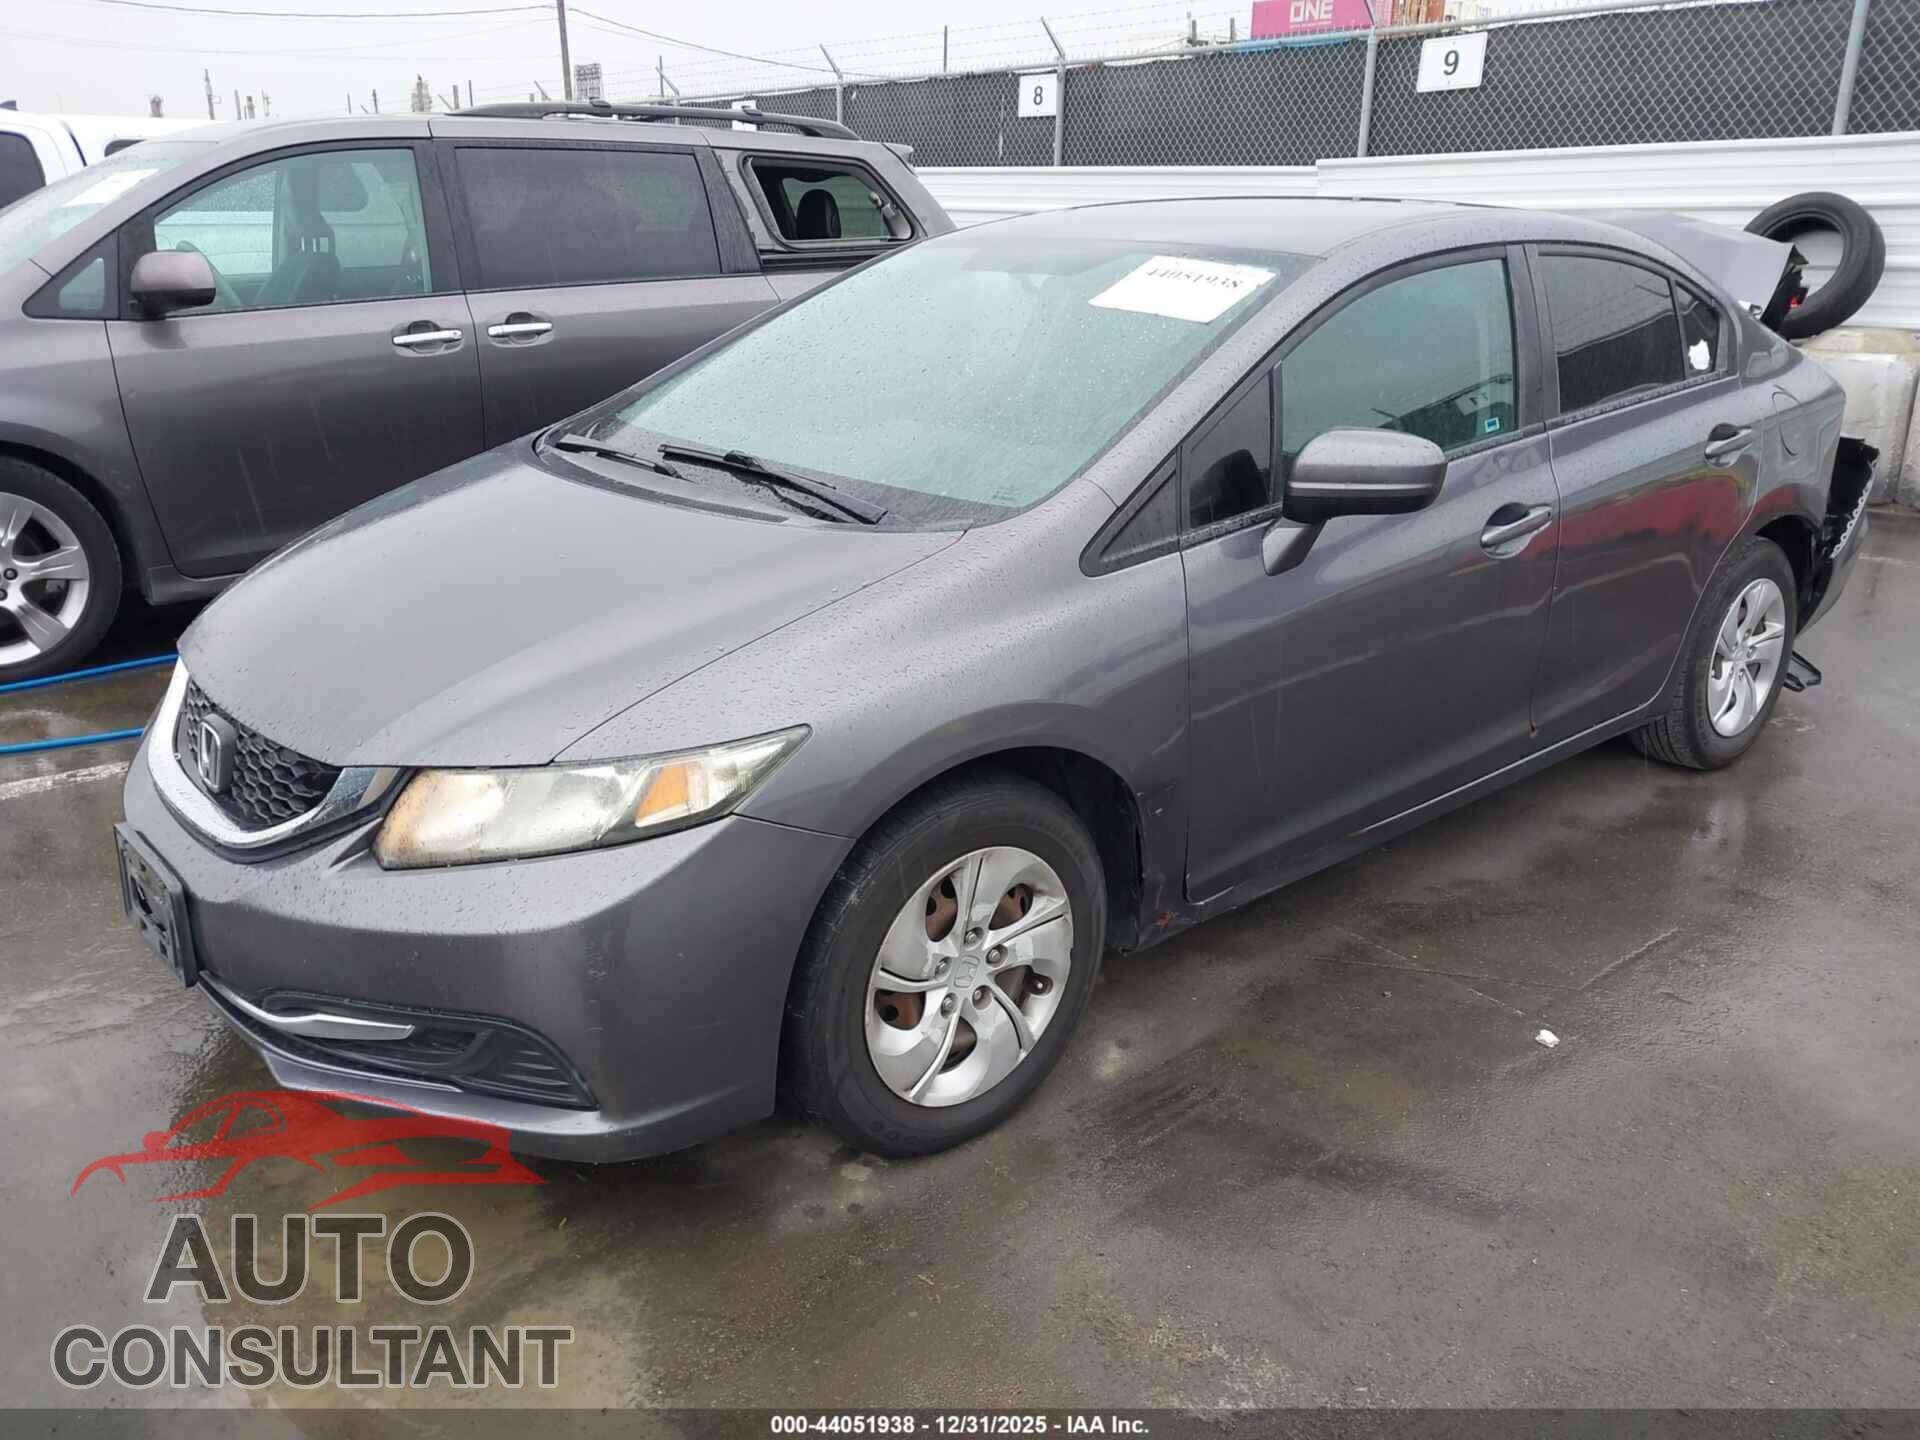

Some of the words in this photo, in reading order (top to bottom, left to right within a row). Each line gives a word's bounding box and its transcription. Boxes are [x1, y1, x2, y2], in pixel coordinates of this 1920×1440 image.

[1289, 0, 1334, 22] ONE
[1443, 49, 1460, 76] 9
[1033, 85, 1043, 105] 8
